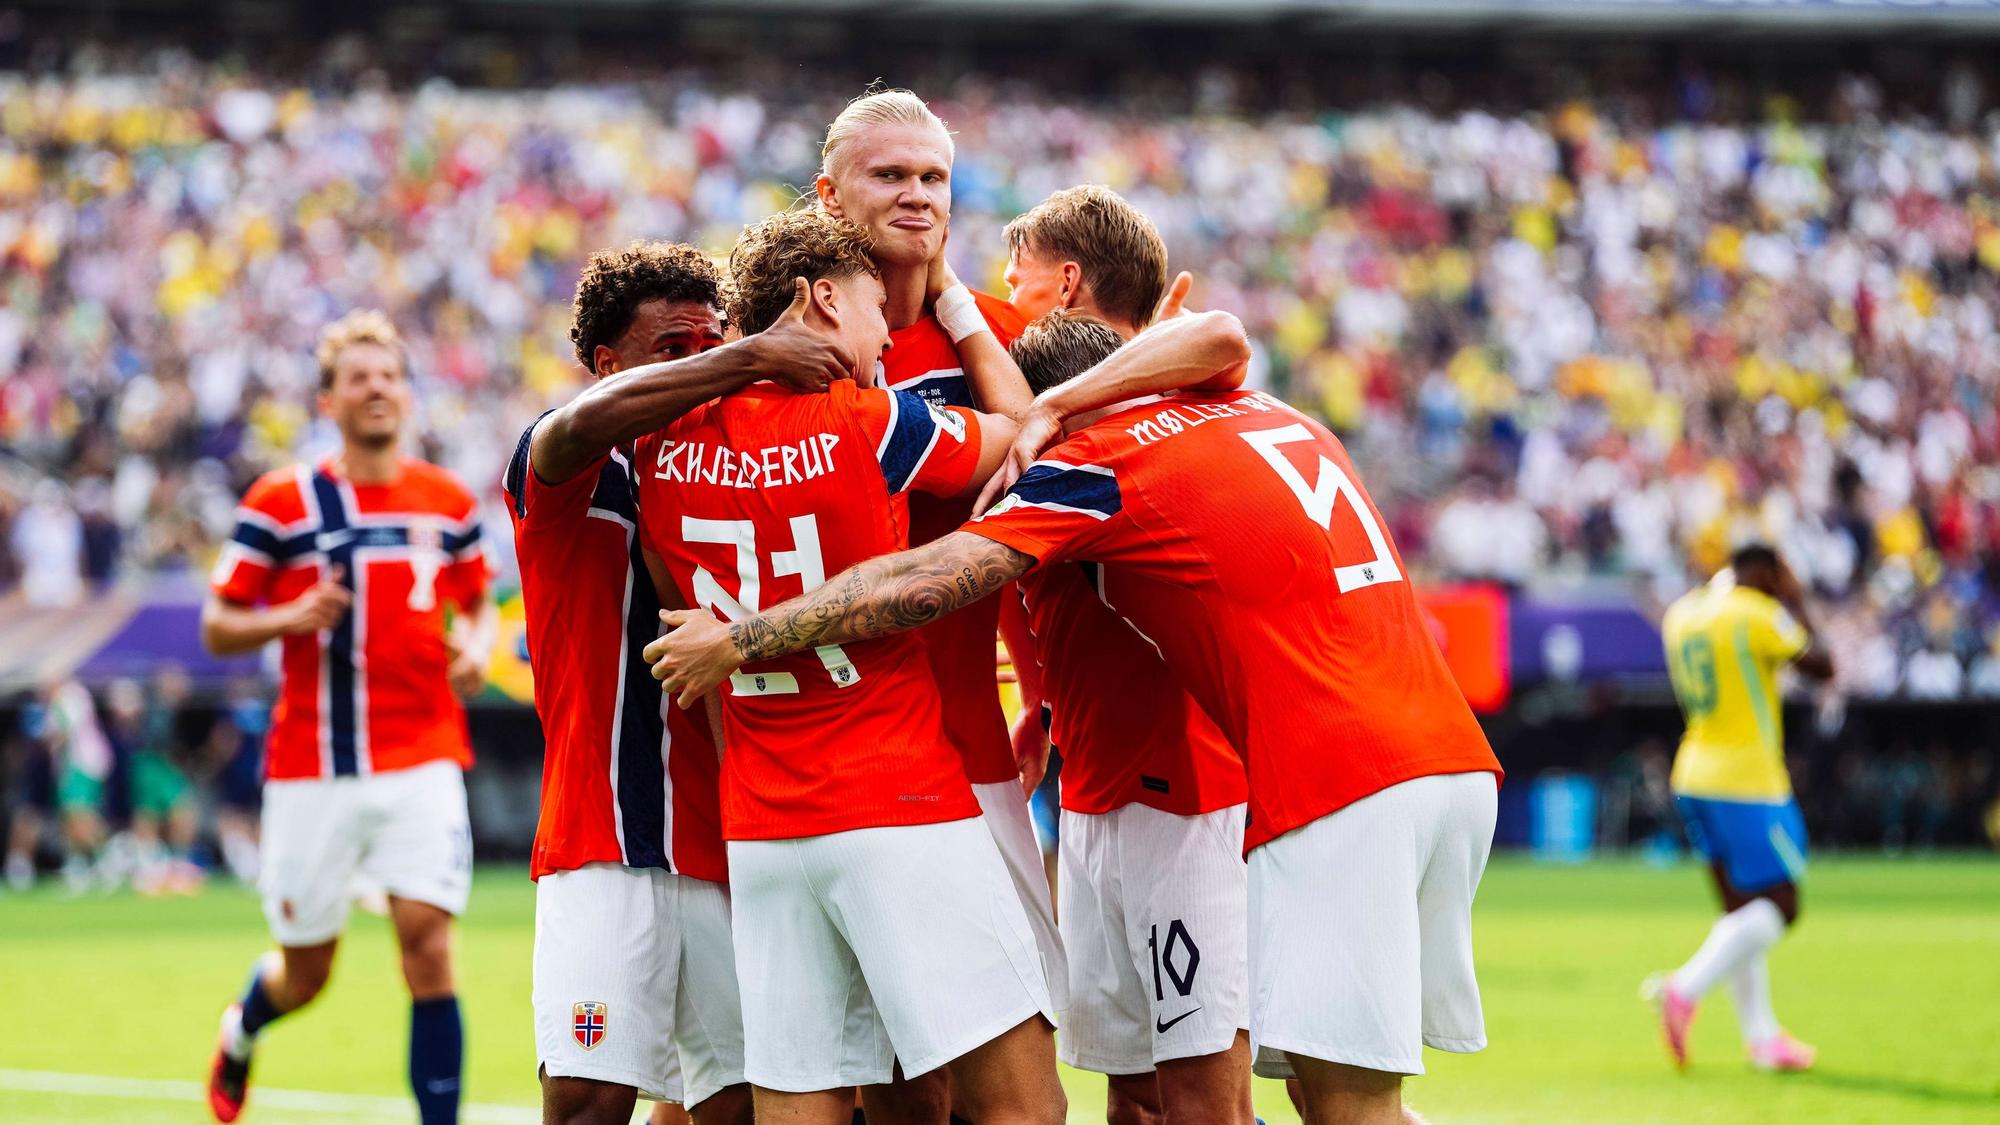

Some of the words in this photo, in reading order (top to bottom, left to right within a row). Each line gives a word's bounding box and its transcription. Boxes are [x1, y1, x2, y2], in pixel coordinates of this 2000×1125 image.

[1237, 422, 1404, 594] 5
[681, 513, 861, 697] 21
[1148, 918, 1201, 1002] 10
